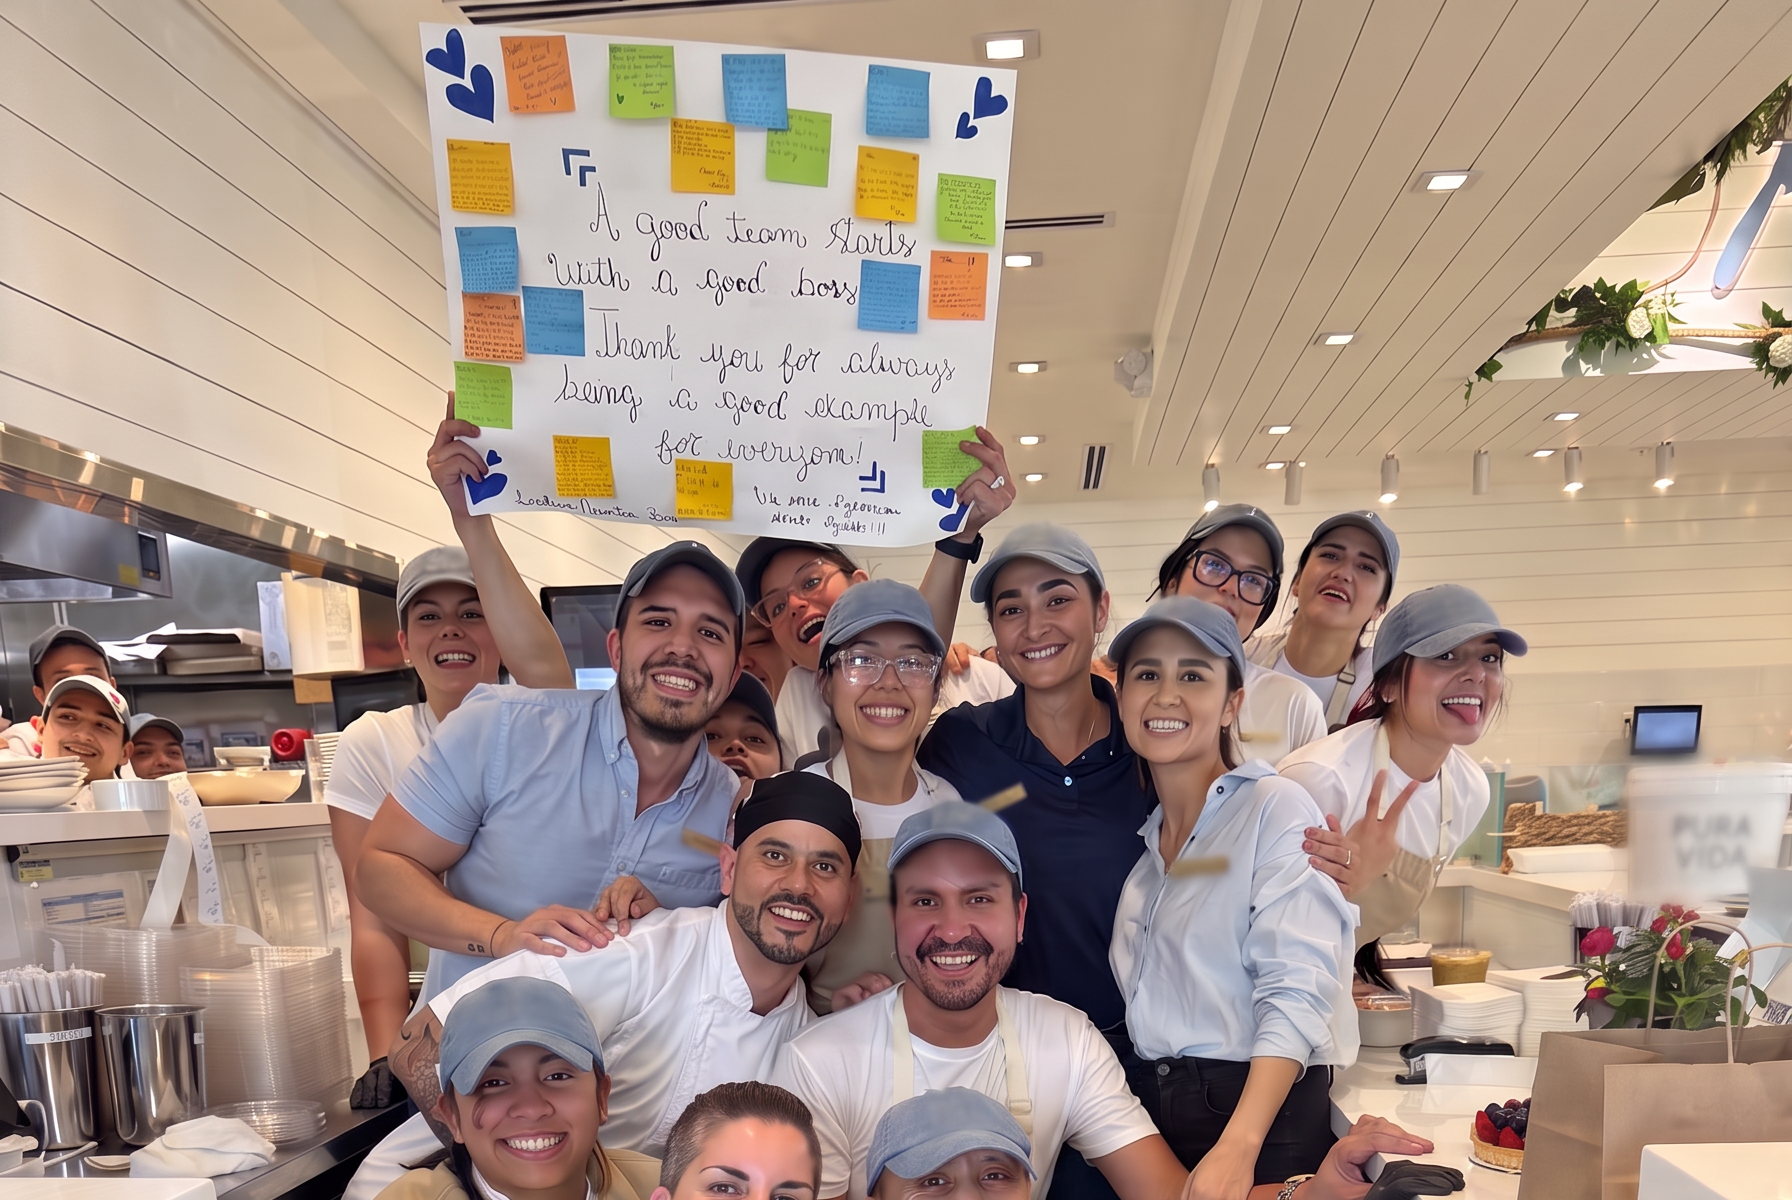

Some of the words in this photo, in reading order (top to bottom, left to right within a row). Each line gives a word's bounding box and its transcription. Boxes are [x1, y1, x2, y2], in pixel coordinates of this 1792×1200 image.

[589, 181, 620, 241] A
[635, 200, 710, 261] good
[726, 211, 807, 248] team
[547, 253, 630, 292] With
[652, 269, 678, 296] a
[696, 260, 768, 306] good
[791, 267, 858, 306] boss
[589, 307, 681, 361] Thank
[700, 343, 763, 384] you
[778, 343, 821, 384] for
[841, 342, 956, 393] always
[554, 363, 642, 423] being
[670, 388, 698, 412] a
[715, 390, 789, 425] good
[805, 393, 932, 442] example
[655, 429, 703, 465] for
[1673, 814, 1752, 839] PURA
[1677, 845, 1746, 869] VIDA
